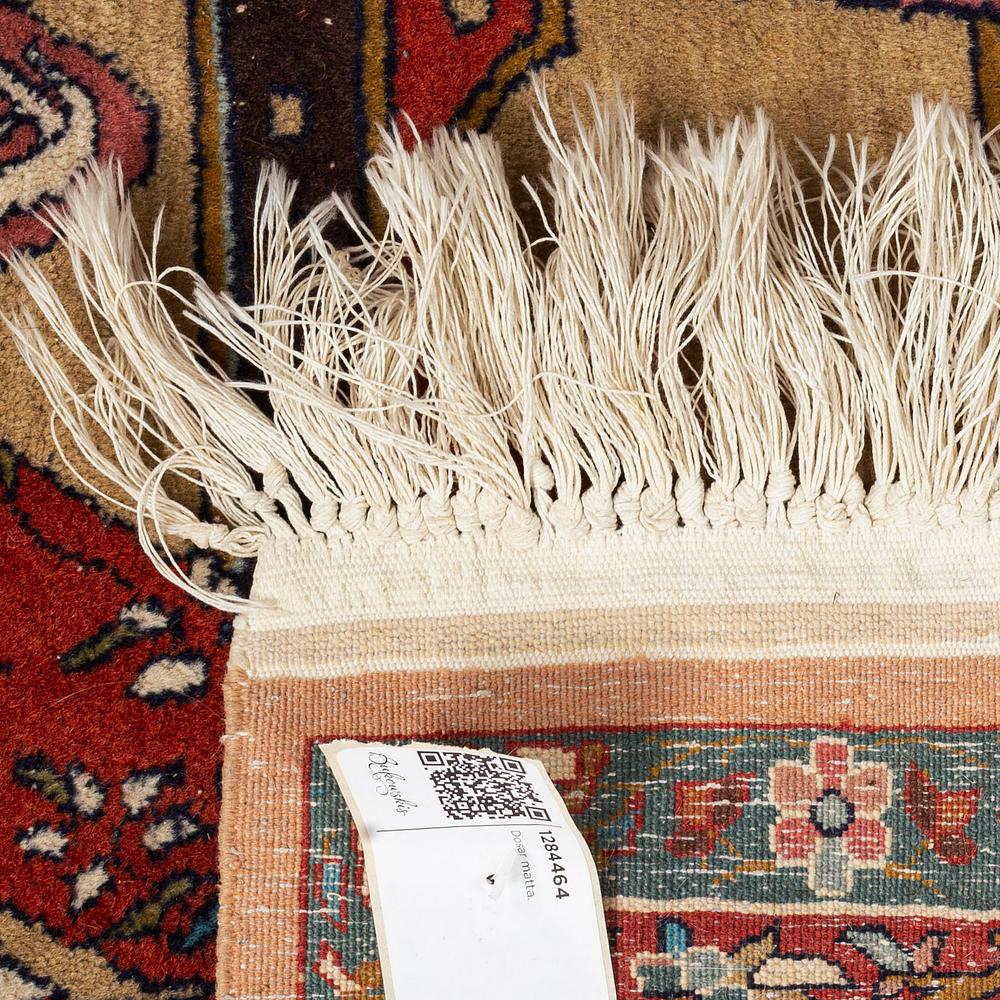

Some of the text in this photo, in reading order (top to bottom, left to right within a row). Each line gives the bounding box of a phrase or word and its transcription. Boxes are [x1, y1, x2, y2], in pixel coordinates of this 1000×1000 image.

[510, 830, 536, 901] Dosar matta.
[539, 830, 570, 900] 1284464
